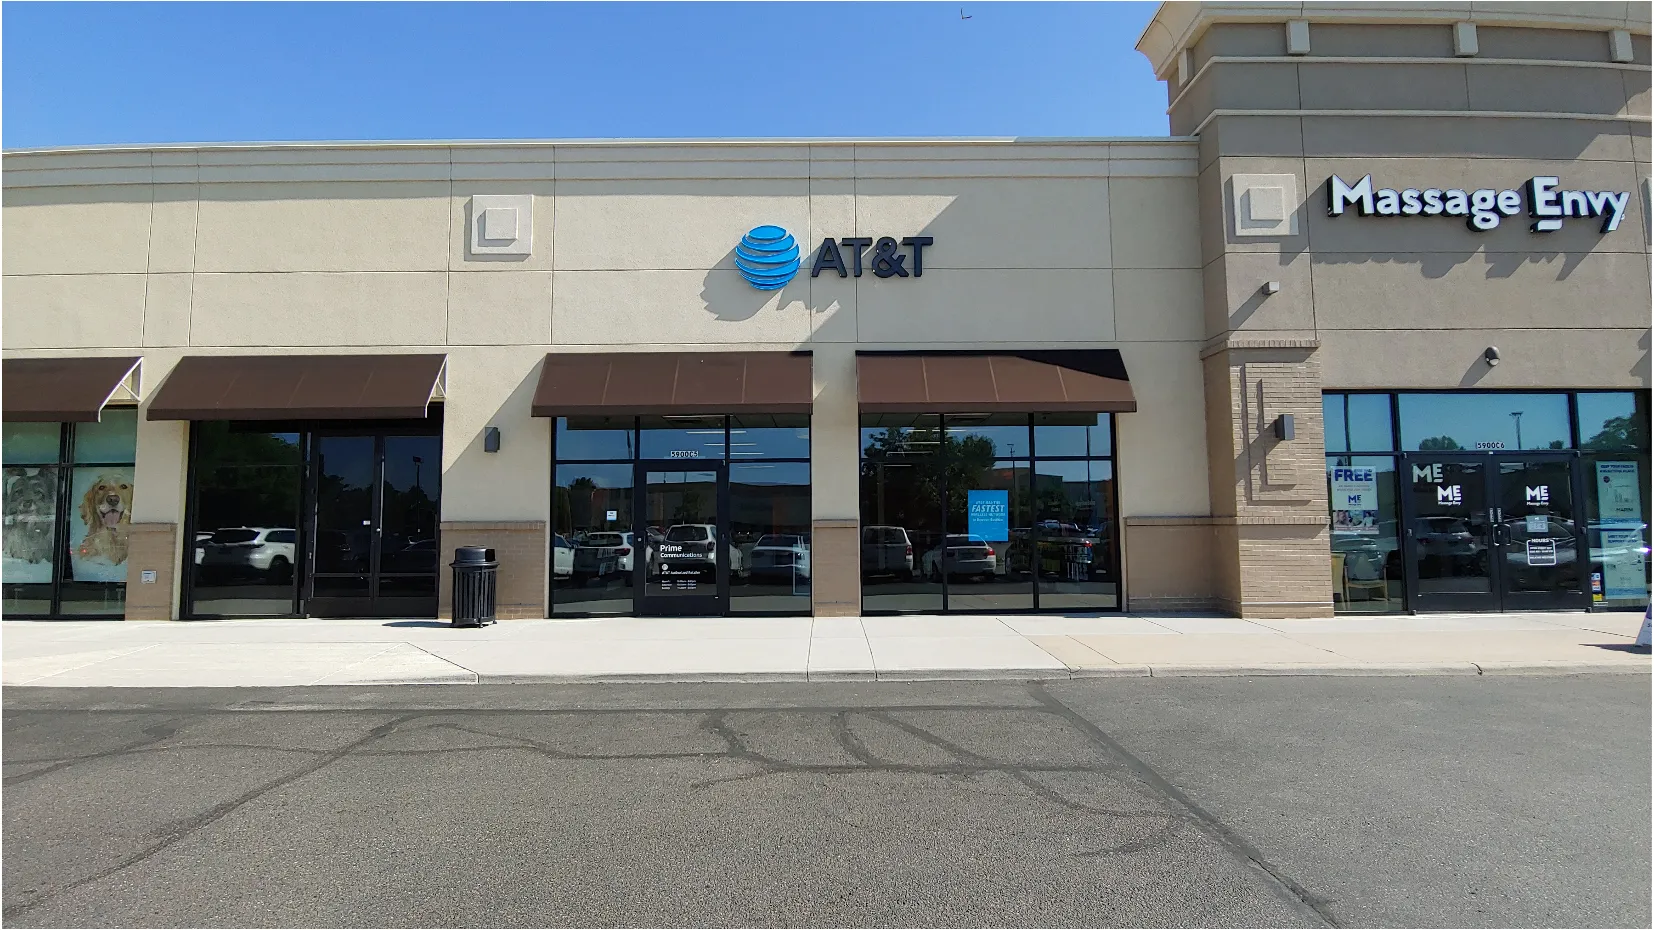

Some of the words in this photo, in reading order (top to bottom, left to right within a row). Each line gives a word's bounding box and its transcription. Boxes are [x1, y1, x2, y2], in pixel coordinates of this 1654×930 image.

[1327, 173, 1521, 231] Massage
[1528, 175, 1630, 233] Envy
[811, 236, 934, 278] AT&T
[1334, 468, 1373, 482] FREE
[1412, 463, 1444, 483] ME
[1348, 494, 1362, 503] ME
[1437, 485, 1462, 501] ME
[1526, 485, 1549, 501] ME
[971, 504, 1005, 513] FASTEST
[660, 544, 683, 552] Prime
